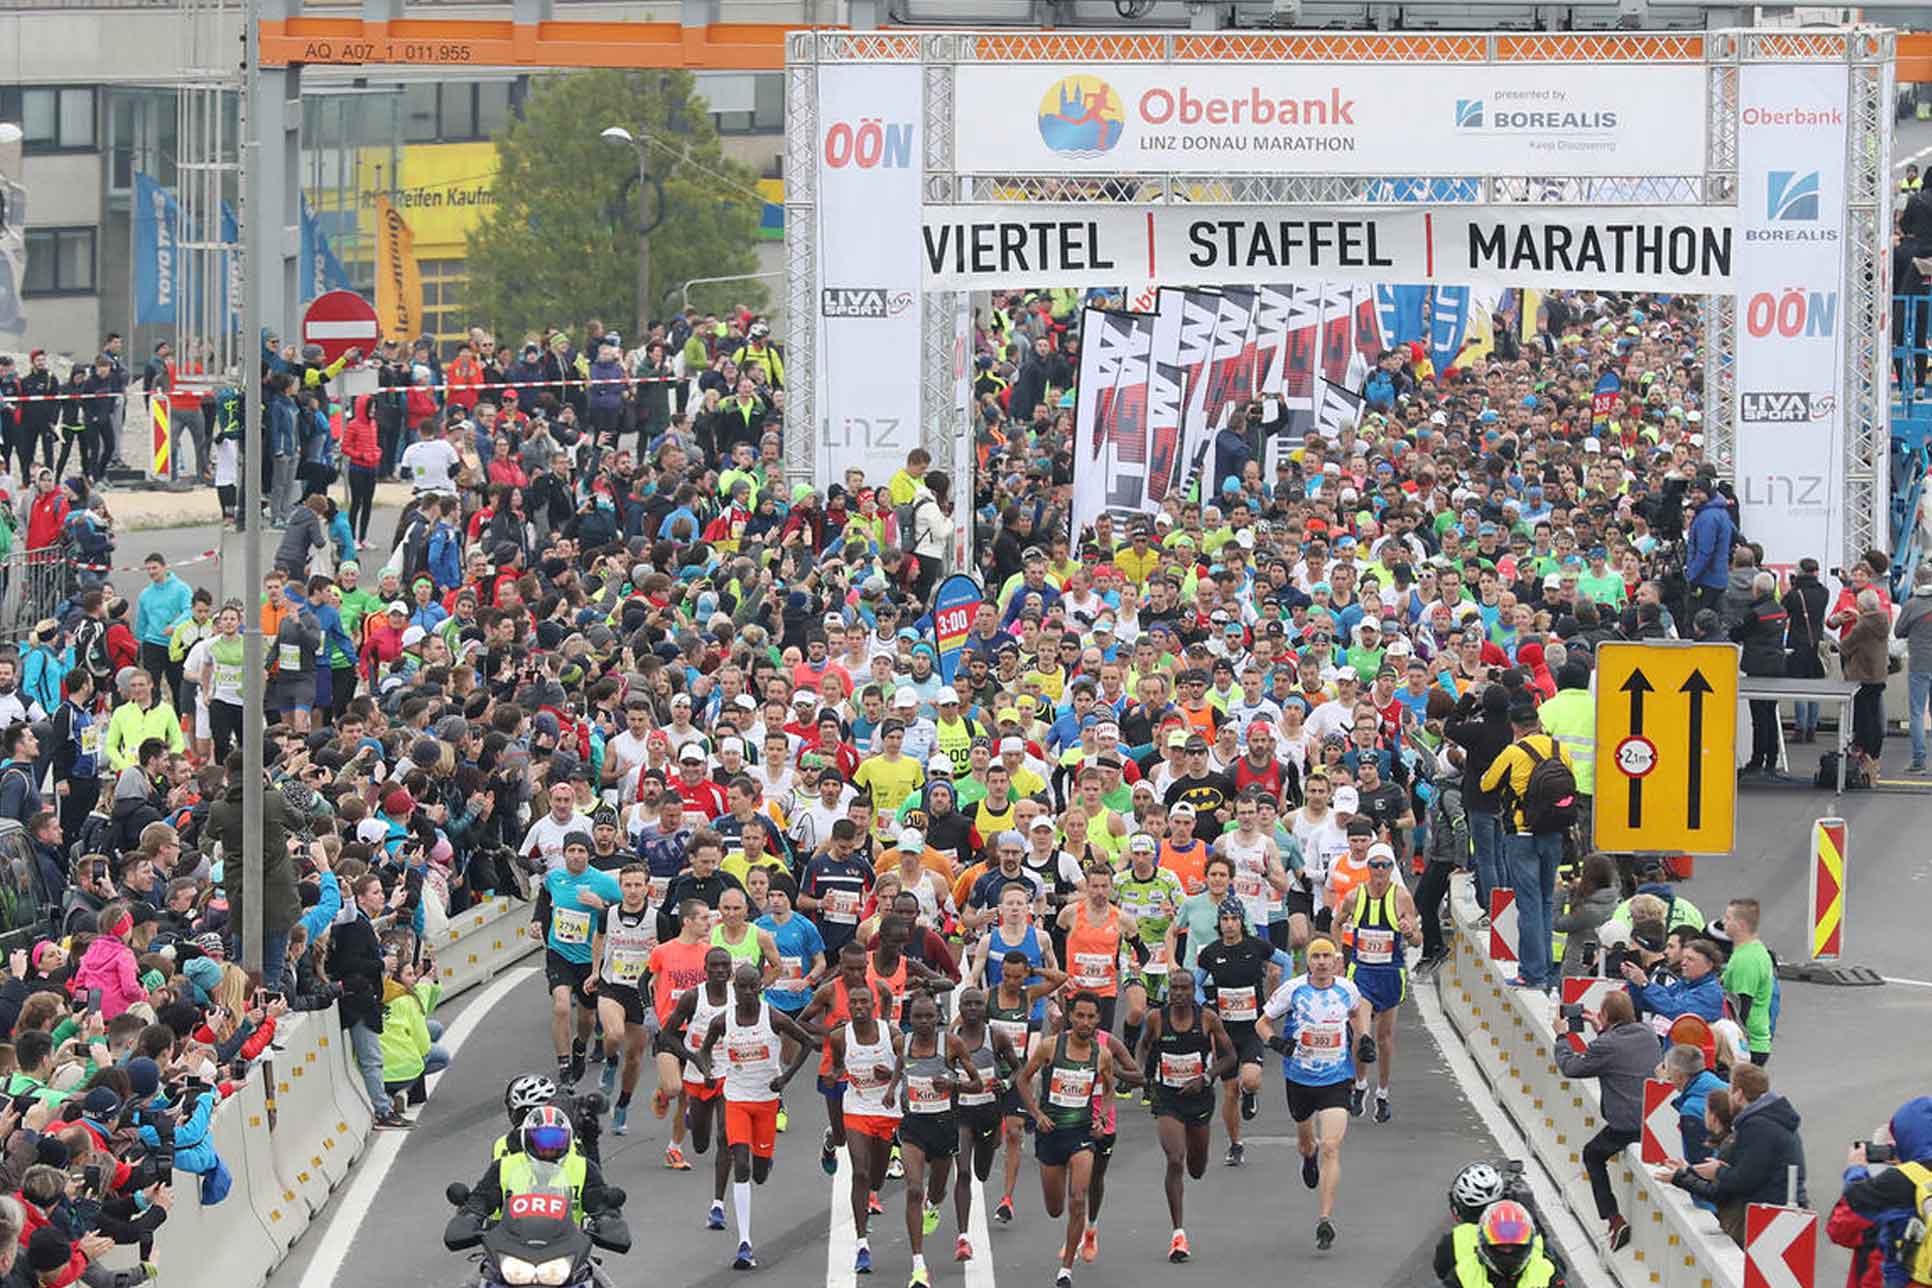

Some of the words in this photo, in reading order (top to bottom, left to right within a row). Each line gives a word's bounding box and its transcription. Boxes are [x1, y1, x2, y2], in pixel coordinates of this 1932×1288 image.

[1494, 89, 1549, 101] presented
[1552, 89, 1567, 102] by
[1139, 87, 1354, 126] Oberbank
[1494, 112, 1617, 128] BOREALIS
[1743, 106, 1842, 126] Oberbank
[825, 118, 913, 169] OÖN
[1140, 136, 1177, 152] LINZ
[1183, 136, 1248, 152] DONAU
[1254, 136, 1355, 152] MARATHON
[1745, 229, 1838, 241] BOREALIS
[923, 222, 1115, 275] VIERTEL
[1189, 221, 1393, 268] STAFFEL
[1469, 222, 1732, 277] MARATHON
[824, 290, 884, 306] LIVA
[824, 305, 884, 316] SPORT
[1747, 286, 1838, 338] OÖN
[1743, 394, 1806, 411] LIVA
[1744, 410, 1806, 420] SPORT
[938, 609, 968, 635] 3:00
[512, 1197, 564, 1214] ORF
